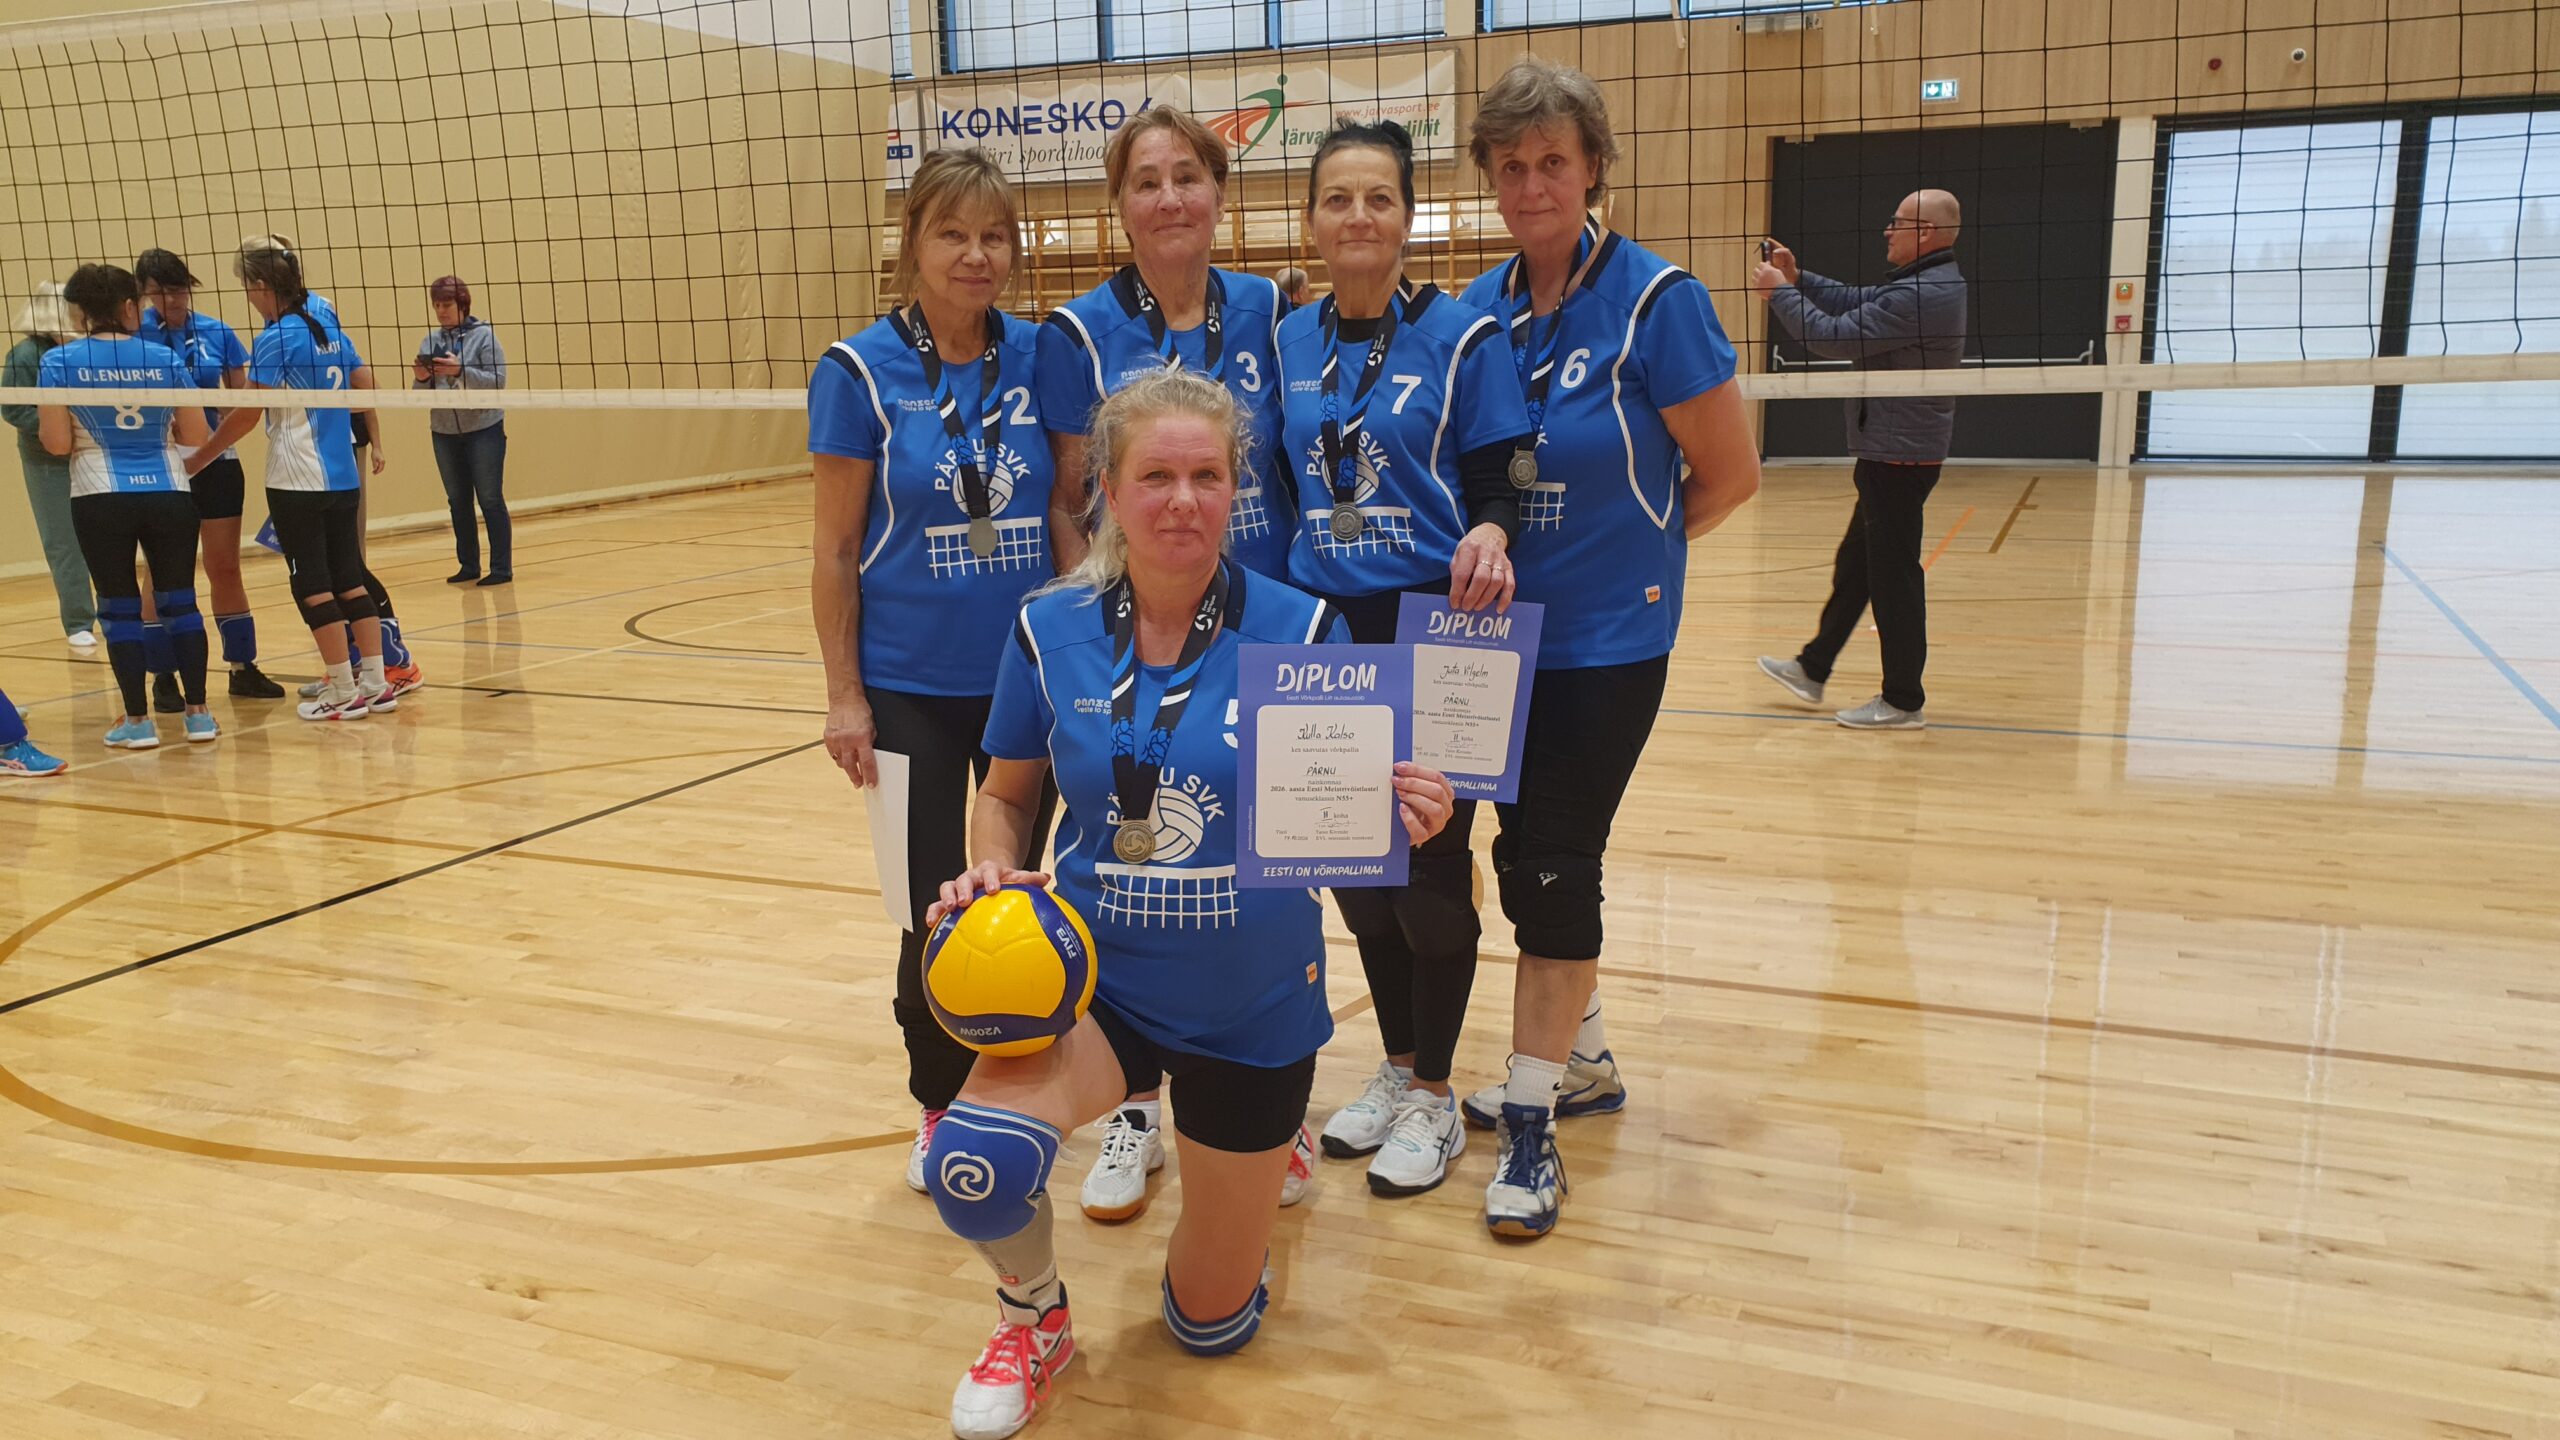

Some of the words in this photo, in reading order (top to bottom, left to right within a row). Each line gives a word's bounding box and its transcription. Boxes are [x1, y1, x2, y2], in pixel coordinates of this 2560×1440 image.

[942, 99, 1126, 140] KONESKO
[1280, 128, 1331, 146] Järva
[77, 367, 164, 382] ÜLENURME
[1236, 351, 1261, 393] 3
[1560, 347, 1591, 389] 6
[1003, 386, 1037, 426] 2
[1391, 374, 1422, 415] 7
[114, 405, 144, 430] 8
[934, 438, 986, 490] PÄRU
[996, 443, 1031, 480] SVK
[1358, 431, 1391, 473] SVK
[129, 474, 157, 485] HELI
[1426, 610, 1512, 640] DIPLOM
[1275, 662, 1377, 693] DIPLOM
[1182, 774, 1225, 823] SVK
[1263, 865, 1292, 877] EESTI
[1295, 866, 1311, 877] ON
[1314, 864, 1383, 877] VÕRKPALLIMAA
[1056, 927, 1077, 959] FIVB
[960, 1026, 1002, 1037] V200W
